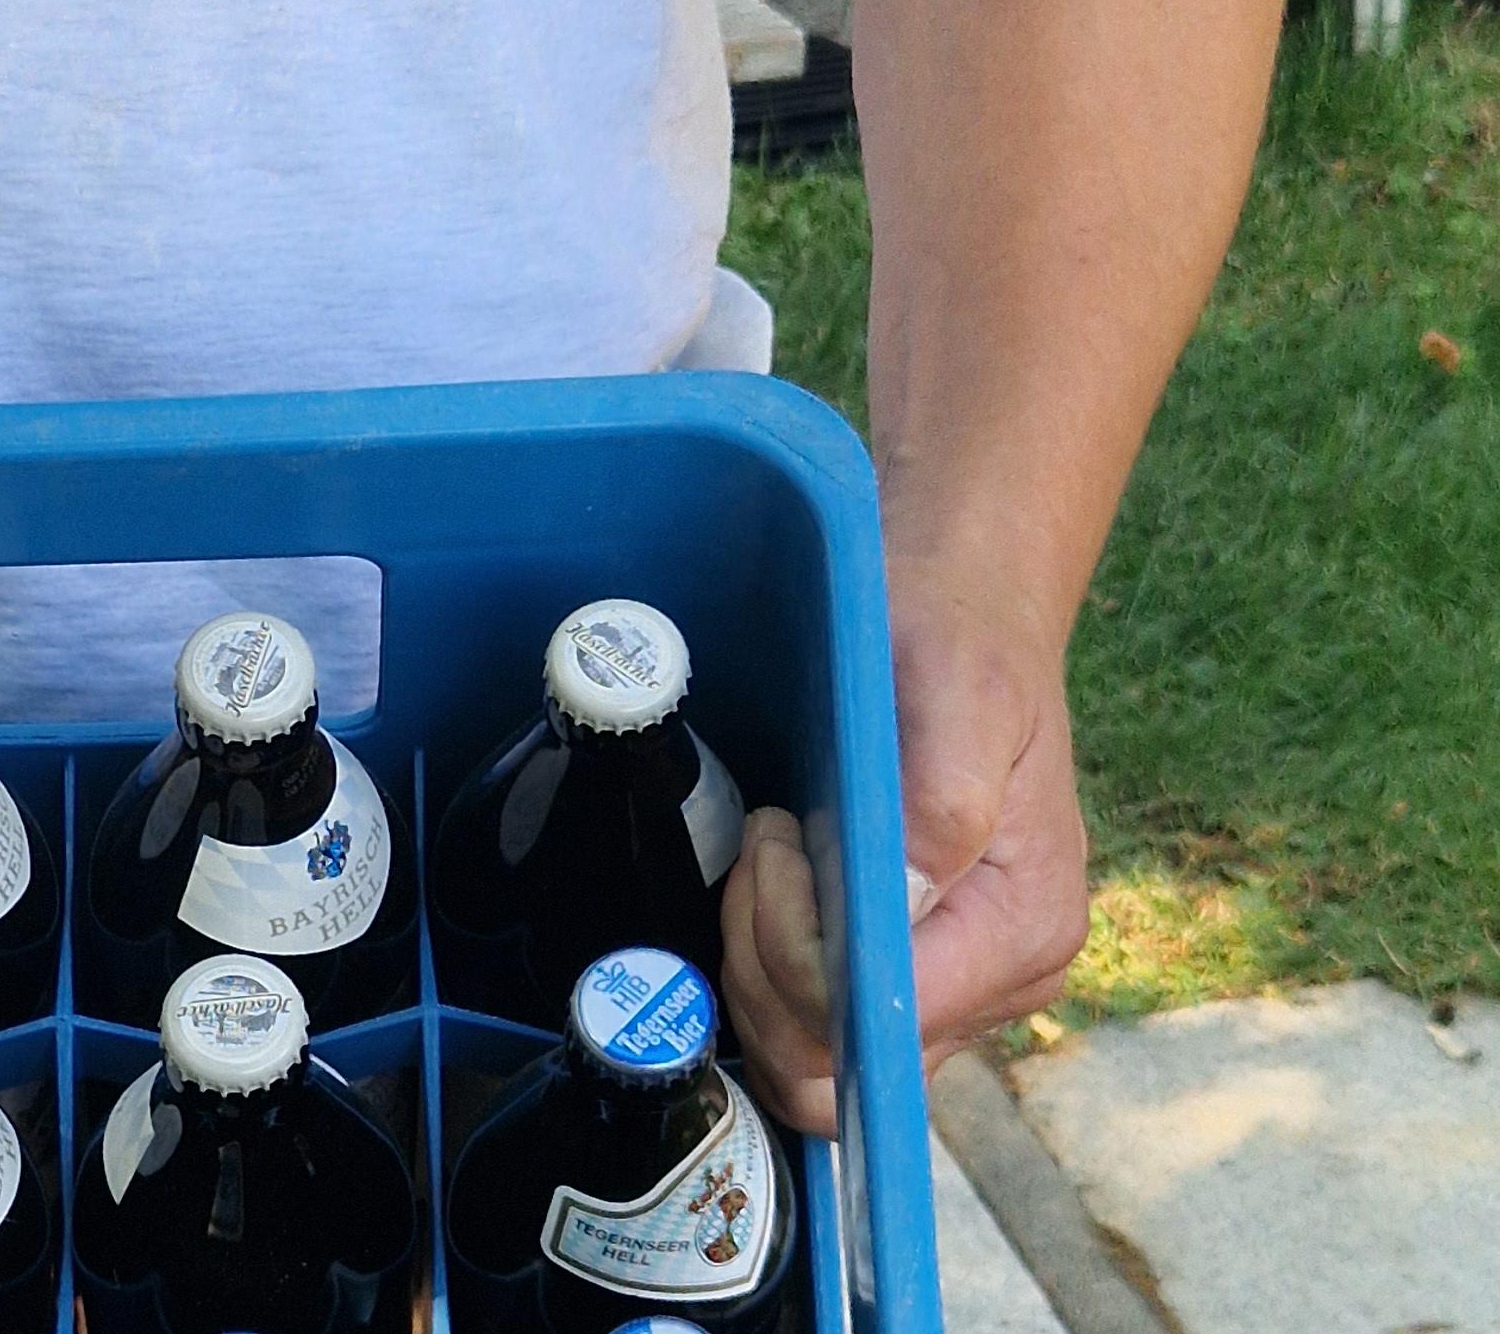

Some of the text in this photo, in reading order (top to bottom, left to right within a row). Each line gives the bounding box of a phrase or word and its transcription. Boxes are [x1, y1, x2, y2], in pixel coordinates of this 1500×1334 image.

[269, 814, 382, 938] BAYRISCH
[319, 877, 382, 943] HELL
[615, 978, 701, 1056] Tegernseer
[661, 1014, 706, 1056] Bier
[576, 1218, 690, 1253] TEGERNSEER
[601, 1243, 650, 1266] HELL
